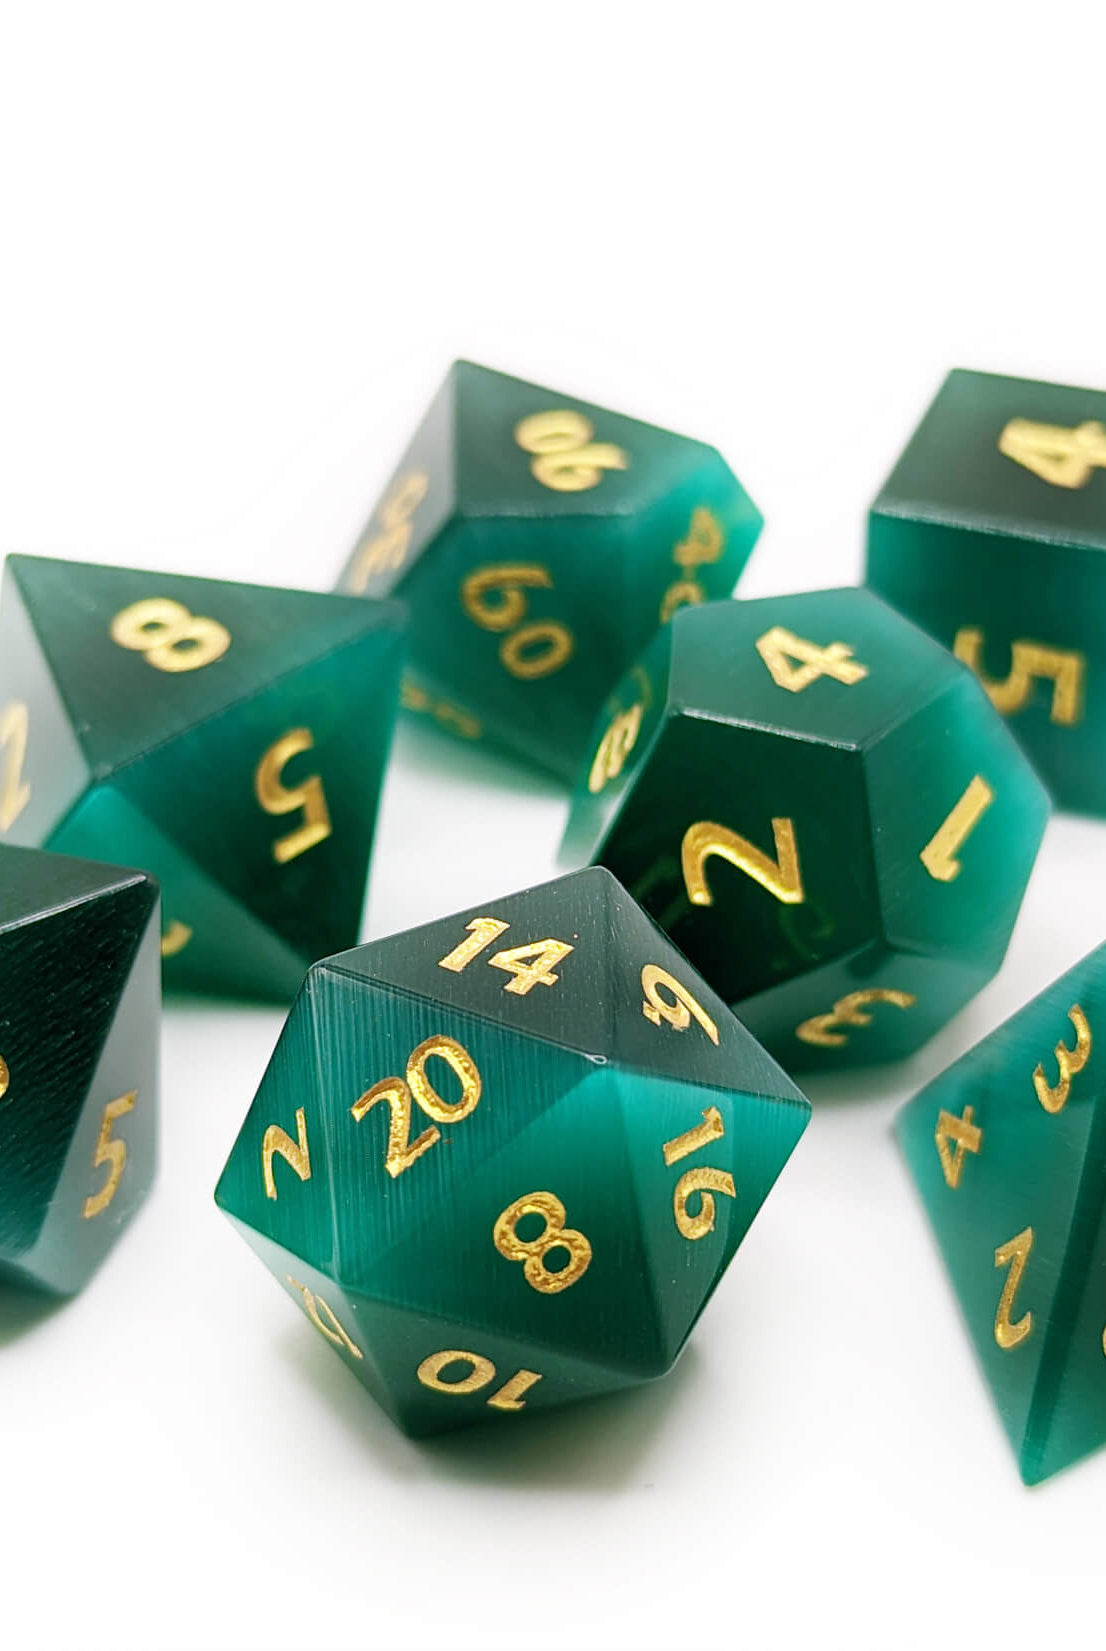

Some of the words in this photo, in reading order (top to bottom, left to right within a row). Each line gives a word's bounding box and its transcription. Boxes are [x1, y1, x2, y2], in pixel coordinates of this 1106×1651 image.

[999, 417, 1106, 489] 4
[111, 598, 231, 673] 8
[463, 565, 573, 680] 60
[756, 627, 868, 693] 4
[953, 628, 1083, 725] 5
[255, 728, 332, 864] 5
[920, 776, 994, 882] 1
[681, 817, 805, 906] 2
[438, 916, 574, 996] 14
[796, 989, 916, 1047] 3
[1032, 1003, 1092, 1114] 3
[262, 1106, 312, 1200] 2
[350, 1034, 482, 1179] 20
[935, 1105, 982, 1188] 4
[83, 1090, 138, 1219] 5
[662, 1105, 737, 1241] 16
[493, 1191, 593, 1294] 8
[416, 1349, 543, 1411] 10
